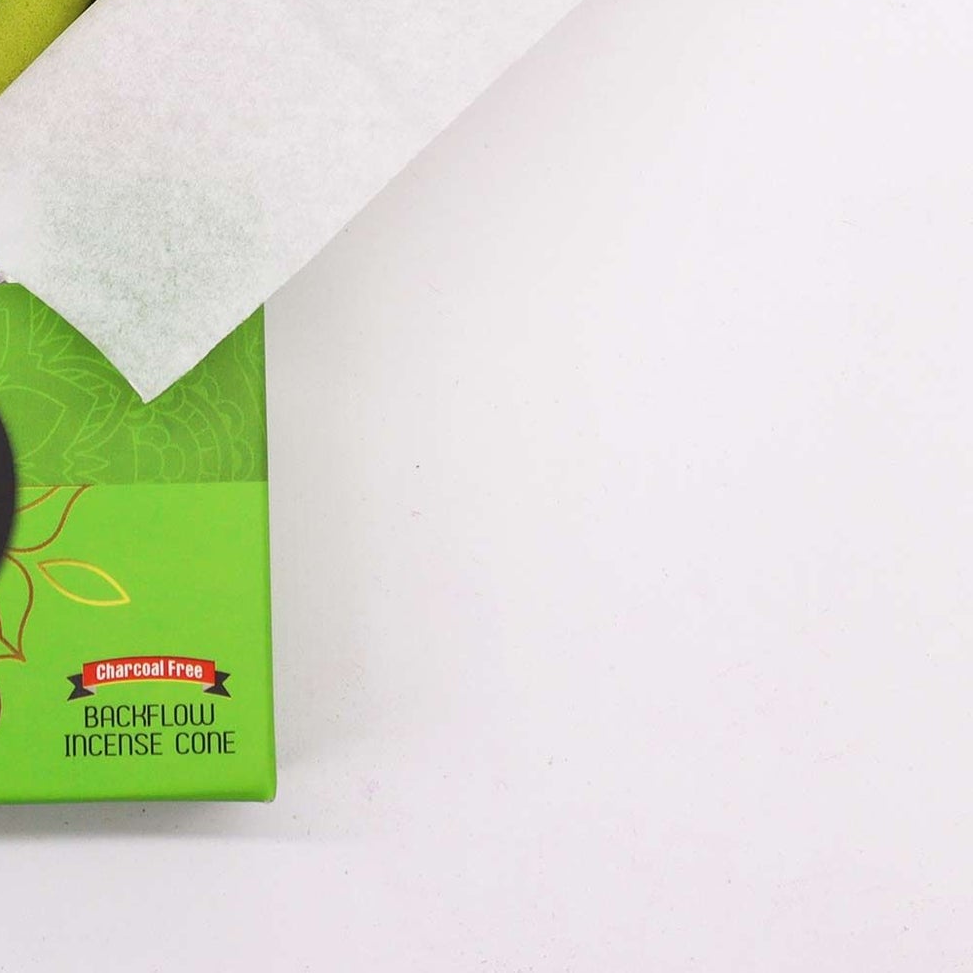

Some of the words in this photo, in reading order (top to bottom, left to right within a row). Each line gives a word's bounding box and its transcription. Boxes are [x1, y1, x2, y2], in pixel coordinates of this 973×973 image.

[96, 661, 164, 681] Charcoal
[168, 659, 203, 679] Free
[84, 703, 215, 728] BACKFLOW
[64, 732, 163, 757] INCENSE
[175, 730, 236, 755] CONE
